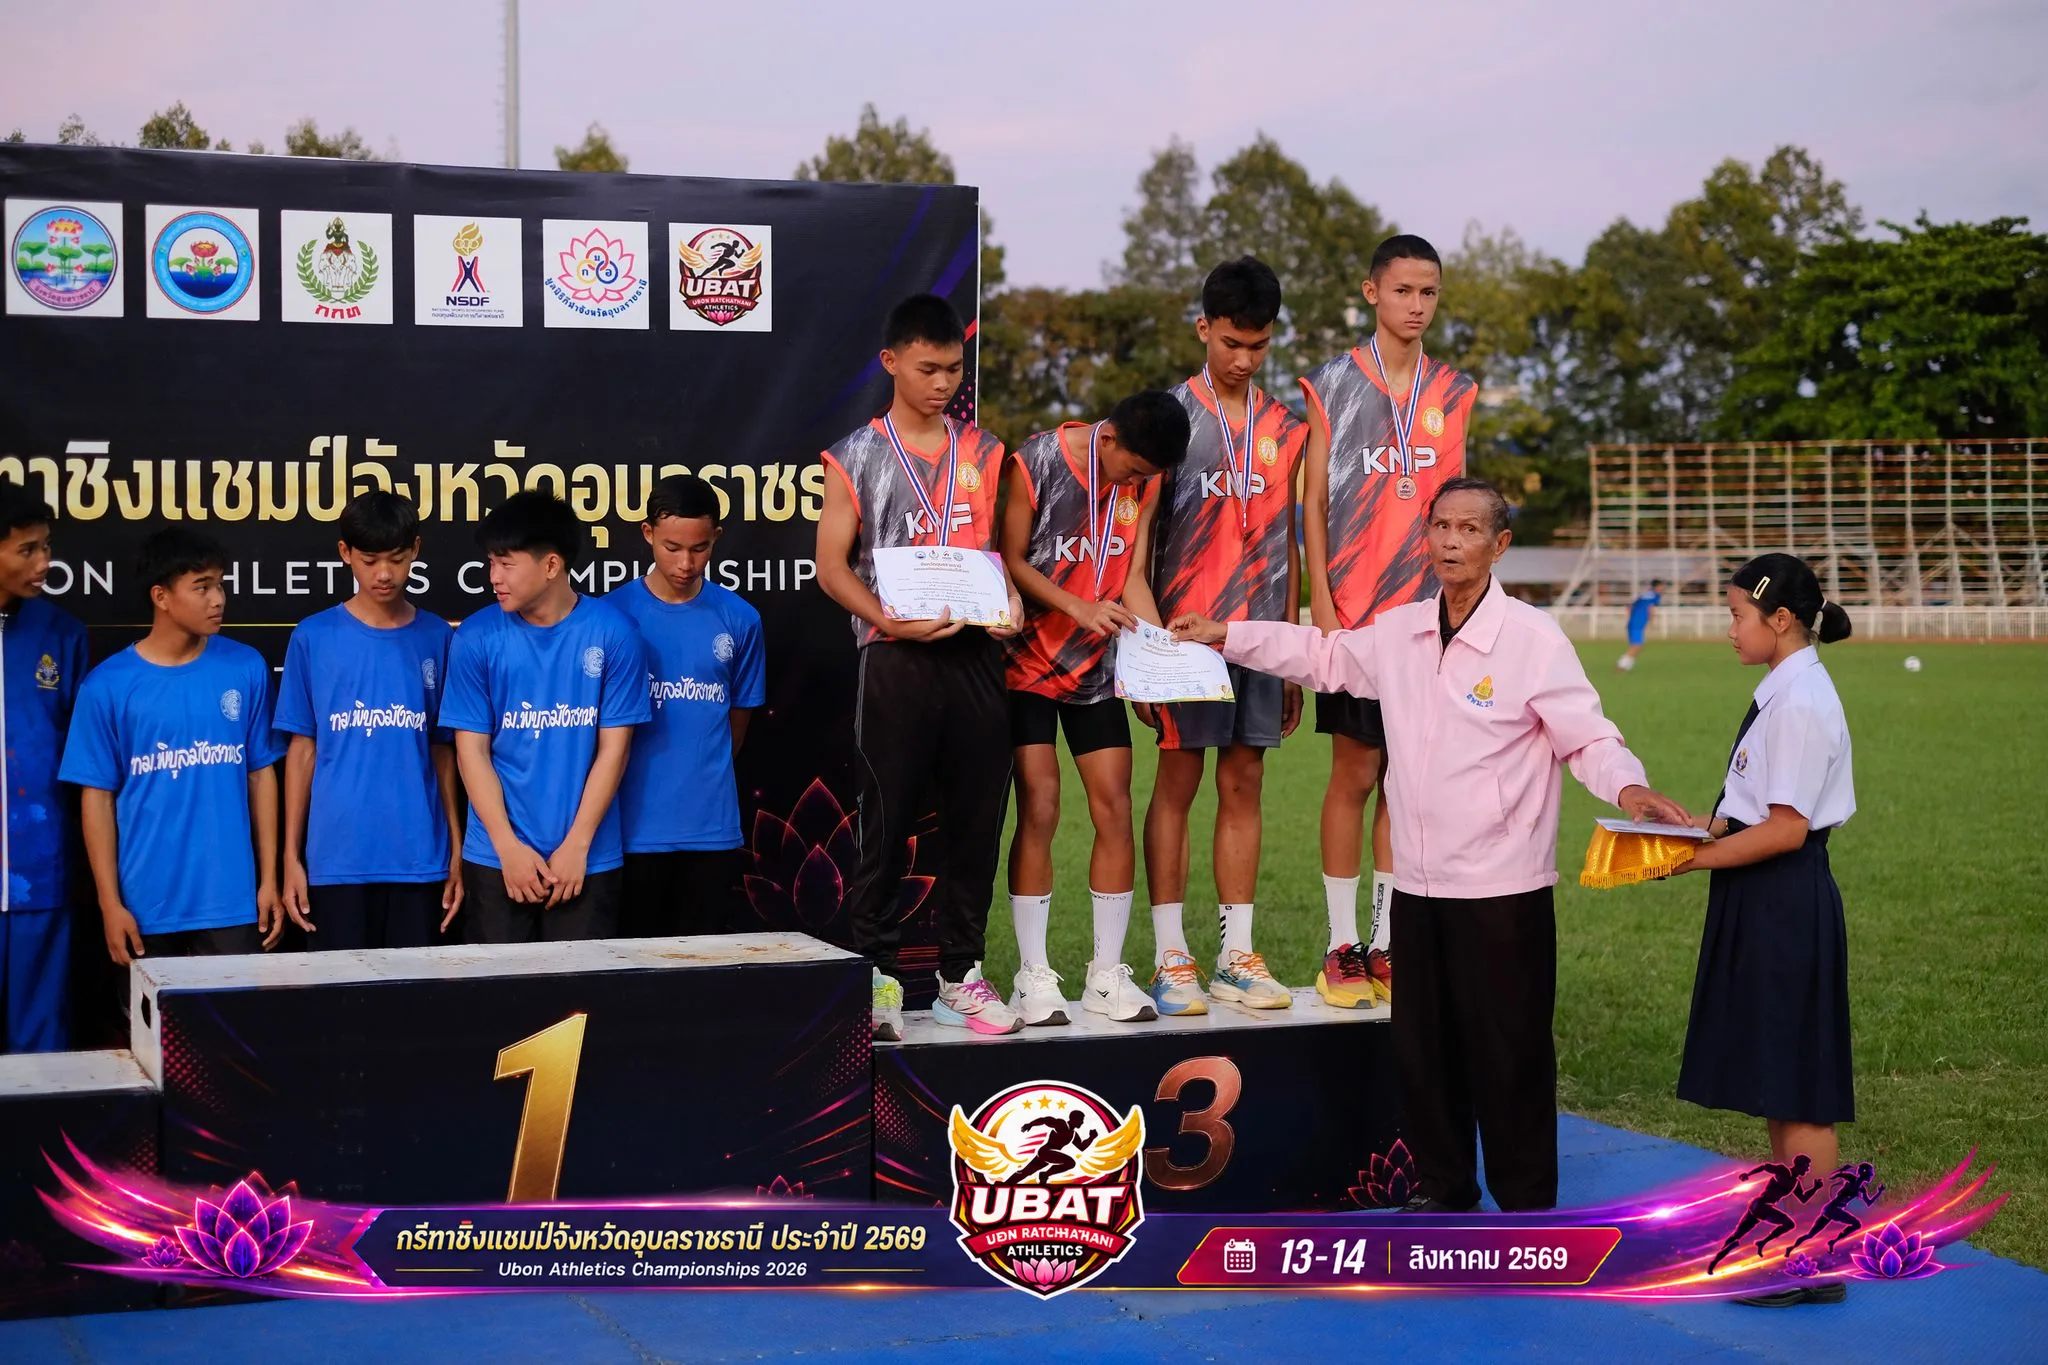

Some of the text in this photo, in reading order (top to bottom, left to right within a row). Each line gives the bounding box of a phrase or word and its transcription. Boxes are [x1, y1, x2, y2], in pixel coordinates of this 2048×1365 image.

[446, 296, 490, 306] NSDF
[685, 278, 756, 298] UBAT
[1362, 446, 1437, 475] KNP
[1200, 468, 1267, 499] KNP
[41, 561, 113, 596] ON
[494, 1013, 588, 1205] 1
[1145, 1055, 1242, 1190] 3
